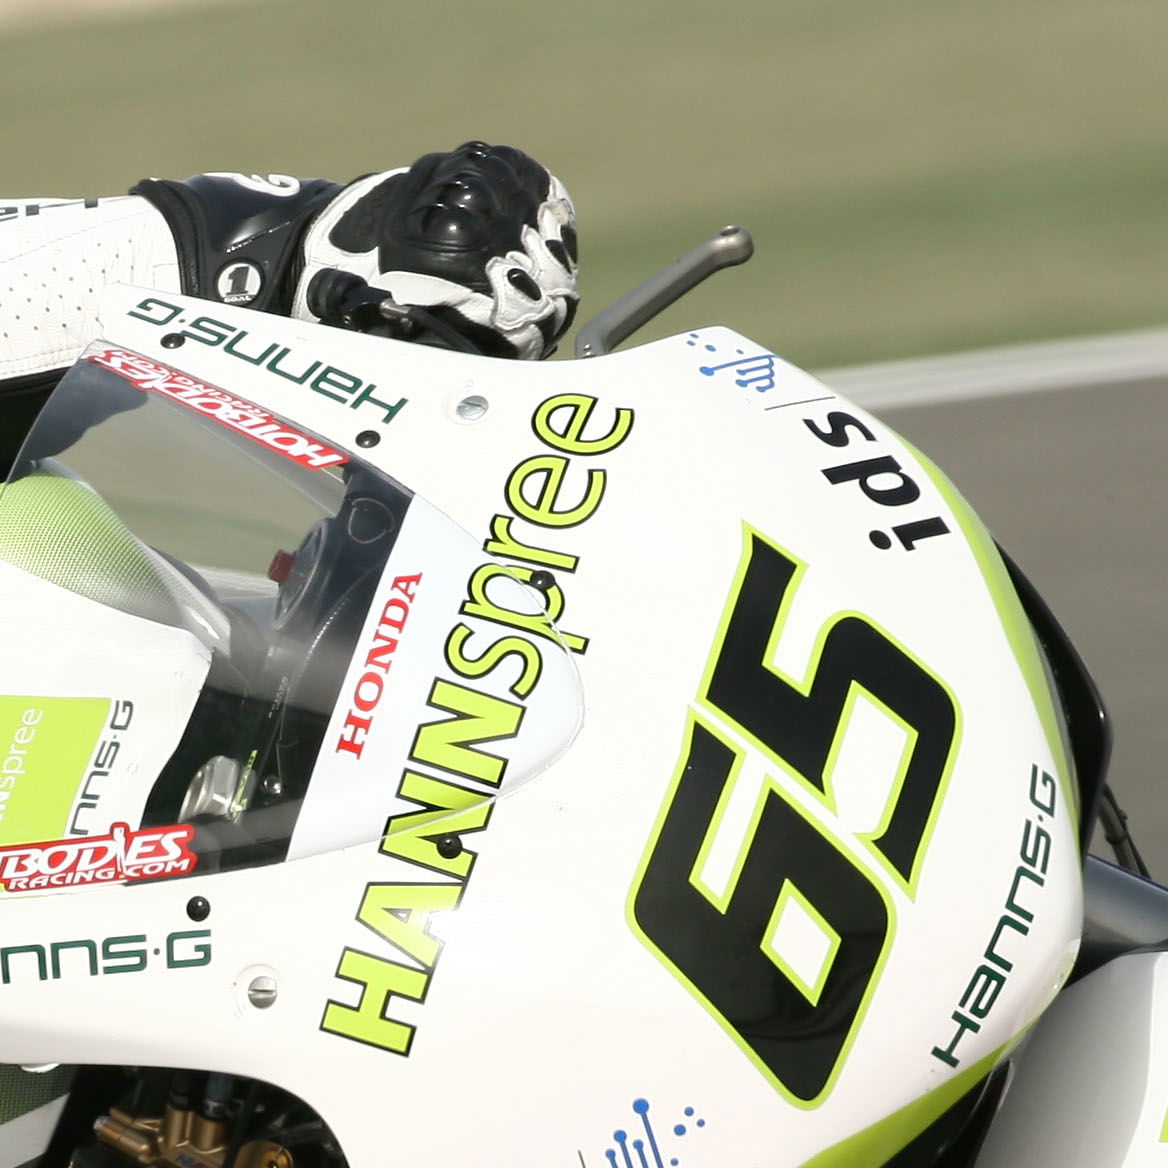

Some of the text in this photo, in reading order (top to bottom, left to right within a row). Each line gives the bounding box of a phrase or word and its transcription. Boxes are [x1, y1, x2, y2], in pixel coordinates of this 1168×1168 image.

[801, 410, 952, 552] ids
[335, 571, 423, 760] HONDA
[625, 518, 964, 1112] 65
